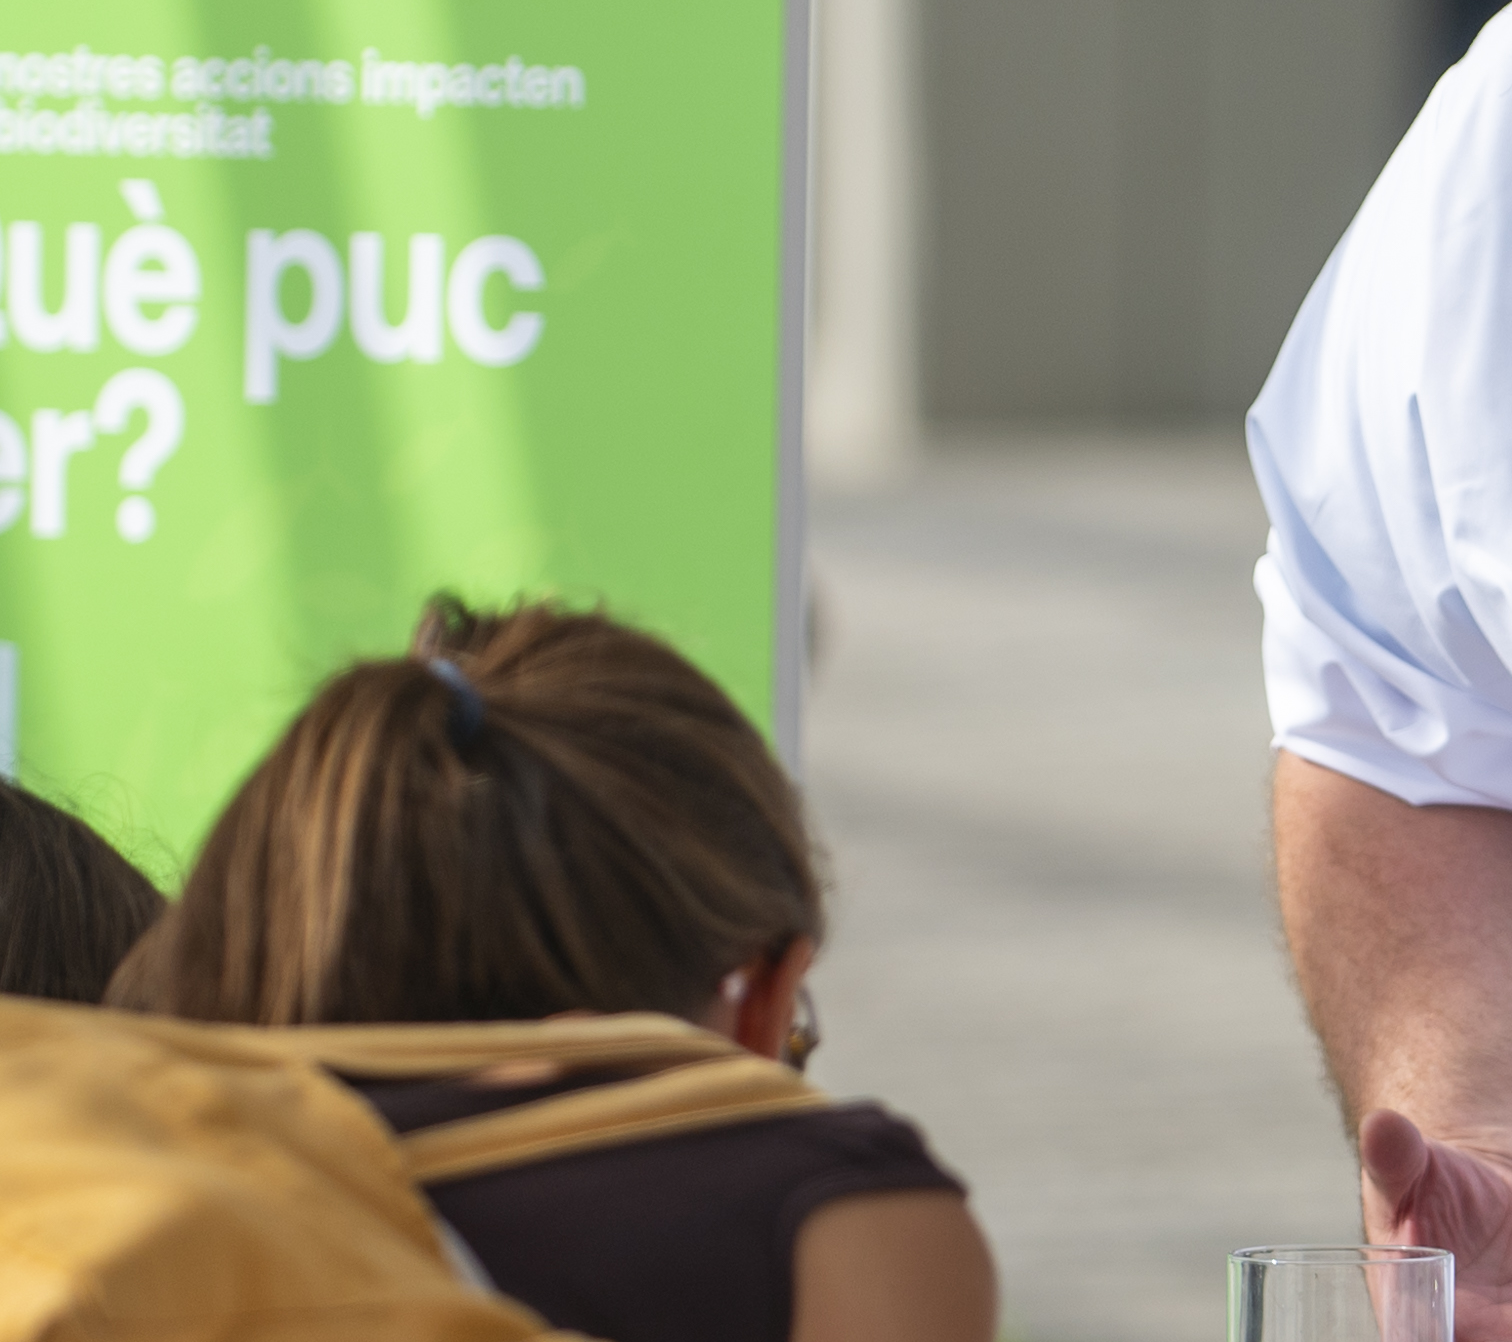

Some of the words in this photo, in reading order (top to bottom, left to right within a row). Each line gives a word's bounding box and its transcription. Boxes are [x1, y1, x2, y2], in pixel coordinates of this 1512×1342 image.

[170, 44, 356, 104] accions
[359, 46, 586, 120] impacten
[245, 226, 546, 404] puc
